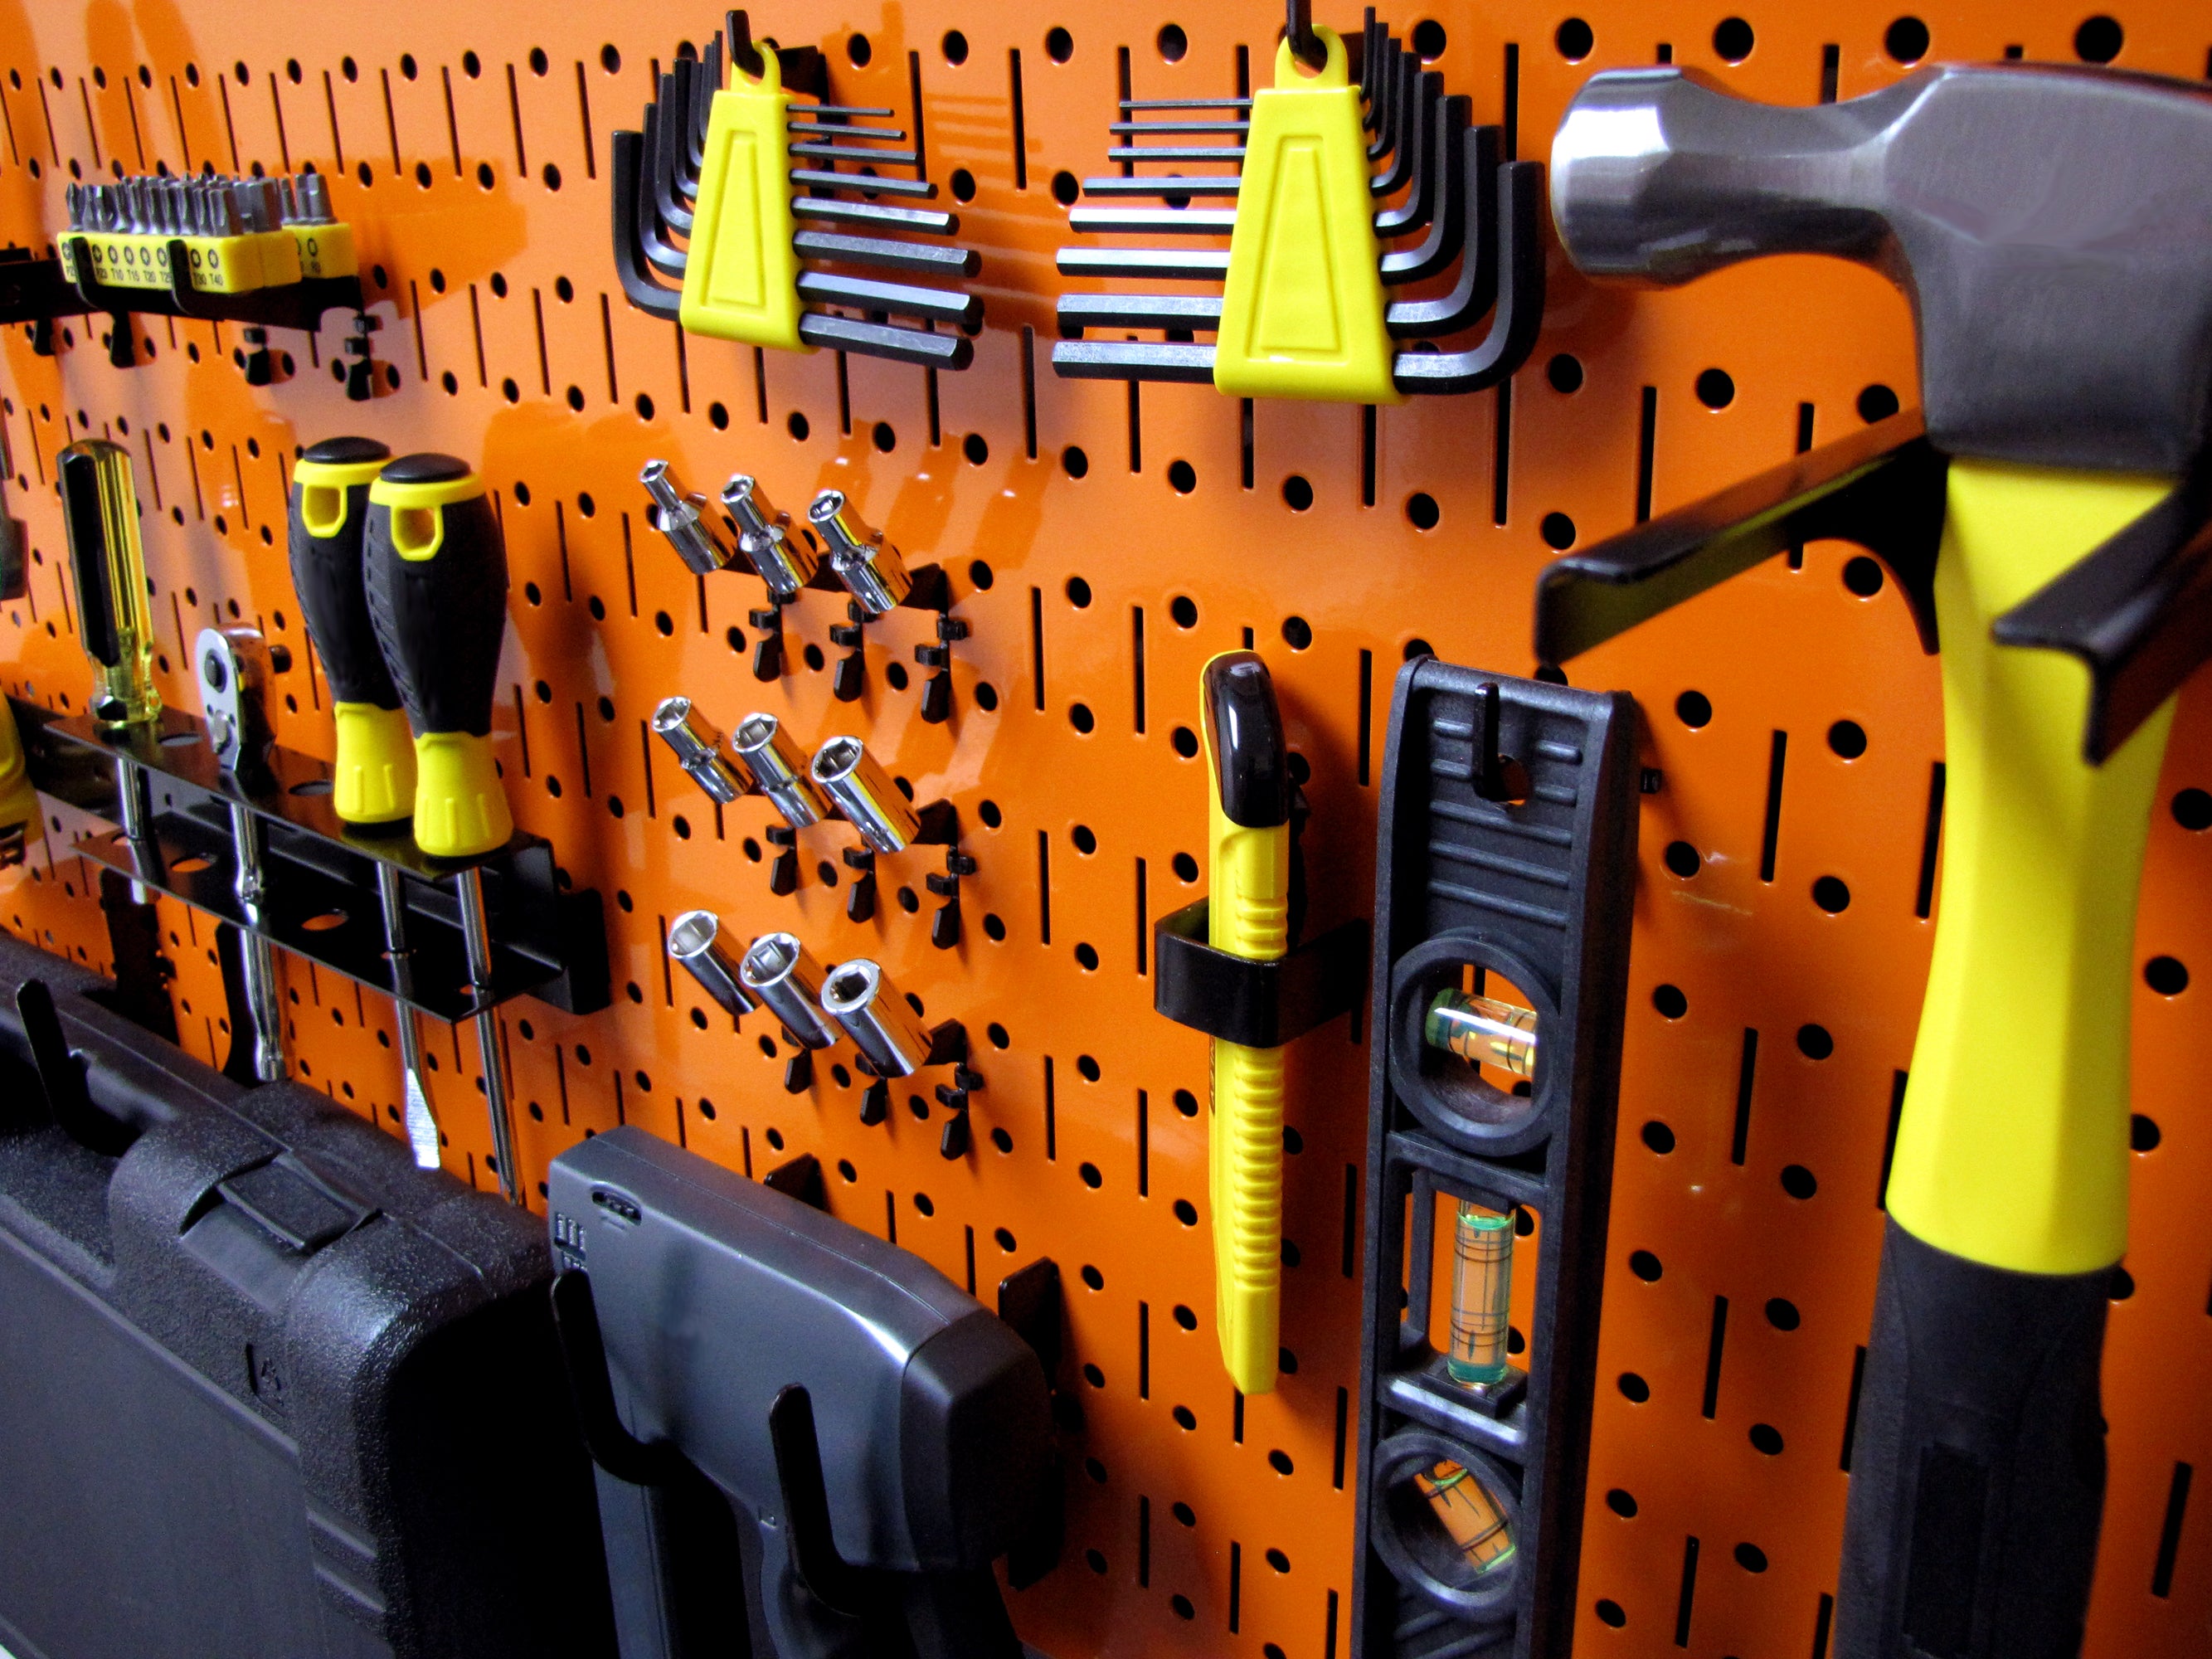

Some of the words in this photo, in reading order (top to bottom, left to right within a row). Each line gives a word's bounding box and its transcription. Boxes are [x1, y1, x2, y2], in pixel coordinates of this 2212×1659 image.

[110, 268, 124, 280] T10
[127, 270, 140, 281] T15
[143, 270, 156, 283] T20
[209, 274, 223, 286] T40
